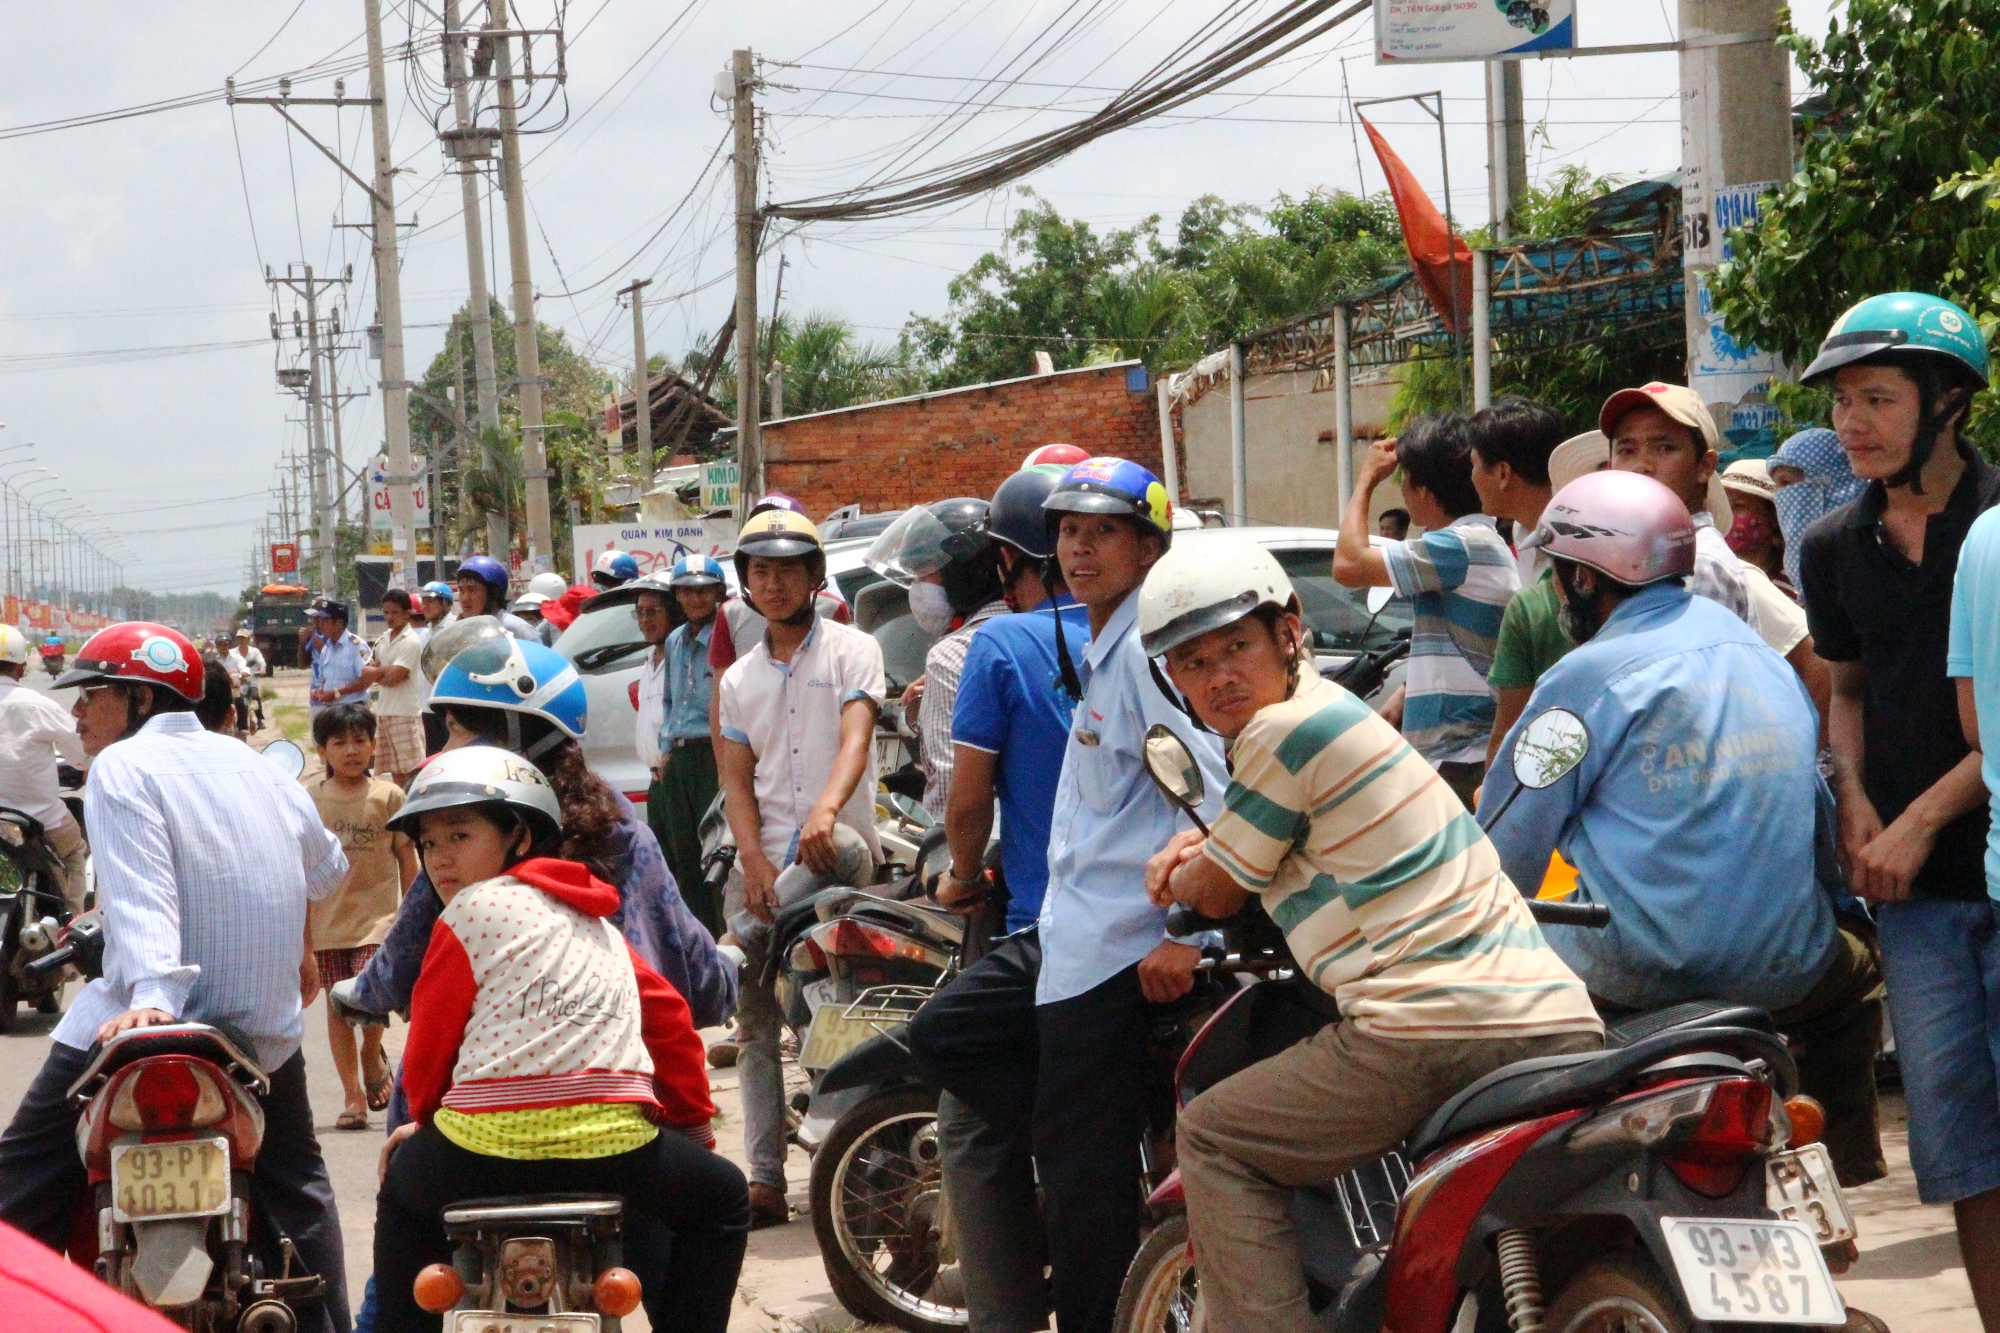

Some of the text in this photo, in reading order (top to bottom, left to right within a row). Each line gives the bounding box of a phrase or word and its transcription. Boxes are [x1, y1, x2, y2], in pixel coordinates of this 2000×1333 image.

[1454, 2, 1477, 10] 9030
[1073, 470, 1111, 482] Red Bull
[655, 529, 672, 539] KIM
[677, 528, 703, 538] OANH
[131, 1146, 214, 1180] 93-P1
[1709, 1272, 1811, 1316] 4587
